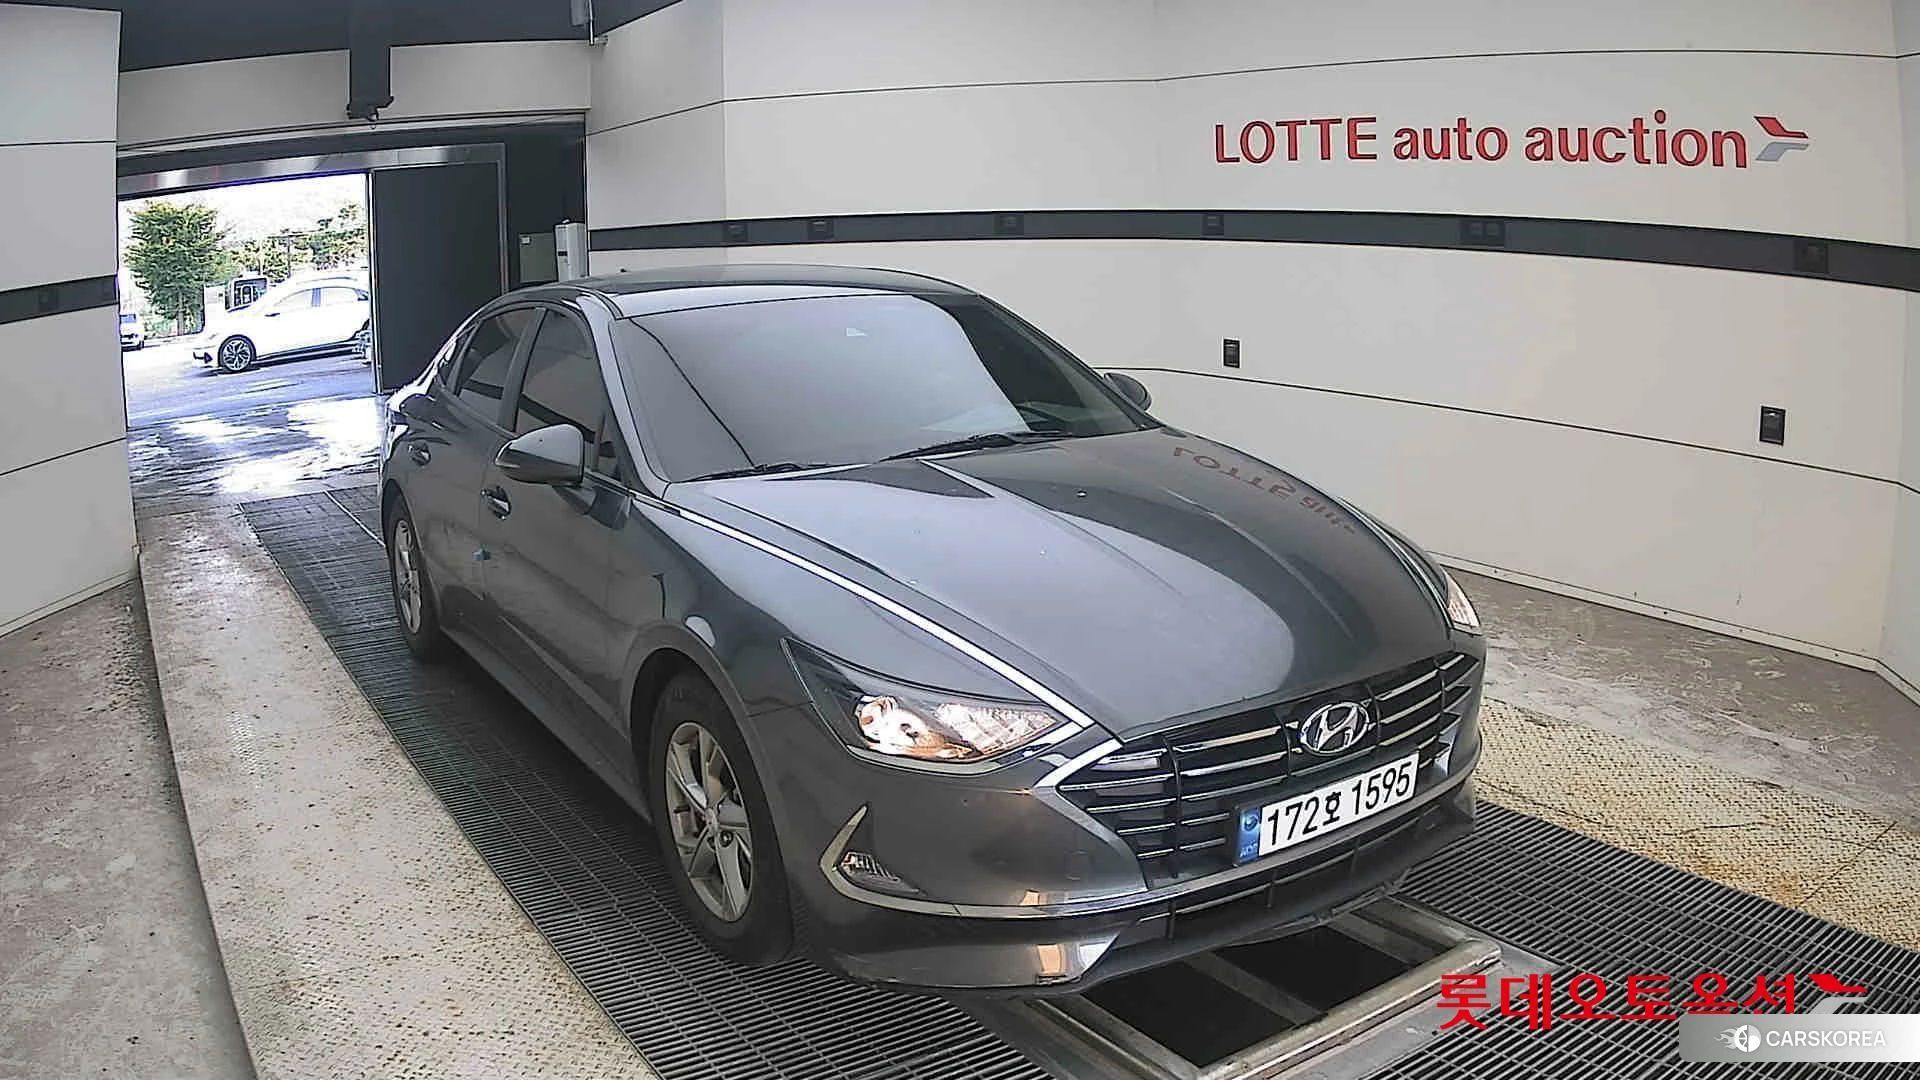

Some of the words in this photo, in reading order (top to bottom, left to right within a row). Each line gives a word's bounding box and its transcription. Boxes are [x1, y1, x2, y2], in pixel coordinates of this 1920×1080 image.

[1215, 117, 1377, 163] LOTTE
[1394, 118, 1509, 161] auto
[1524, 110, 1748, 168] auction
[1352, 761, 1412, 815] 1595
